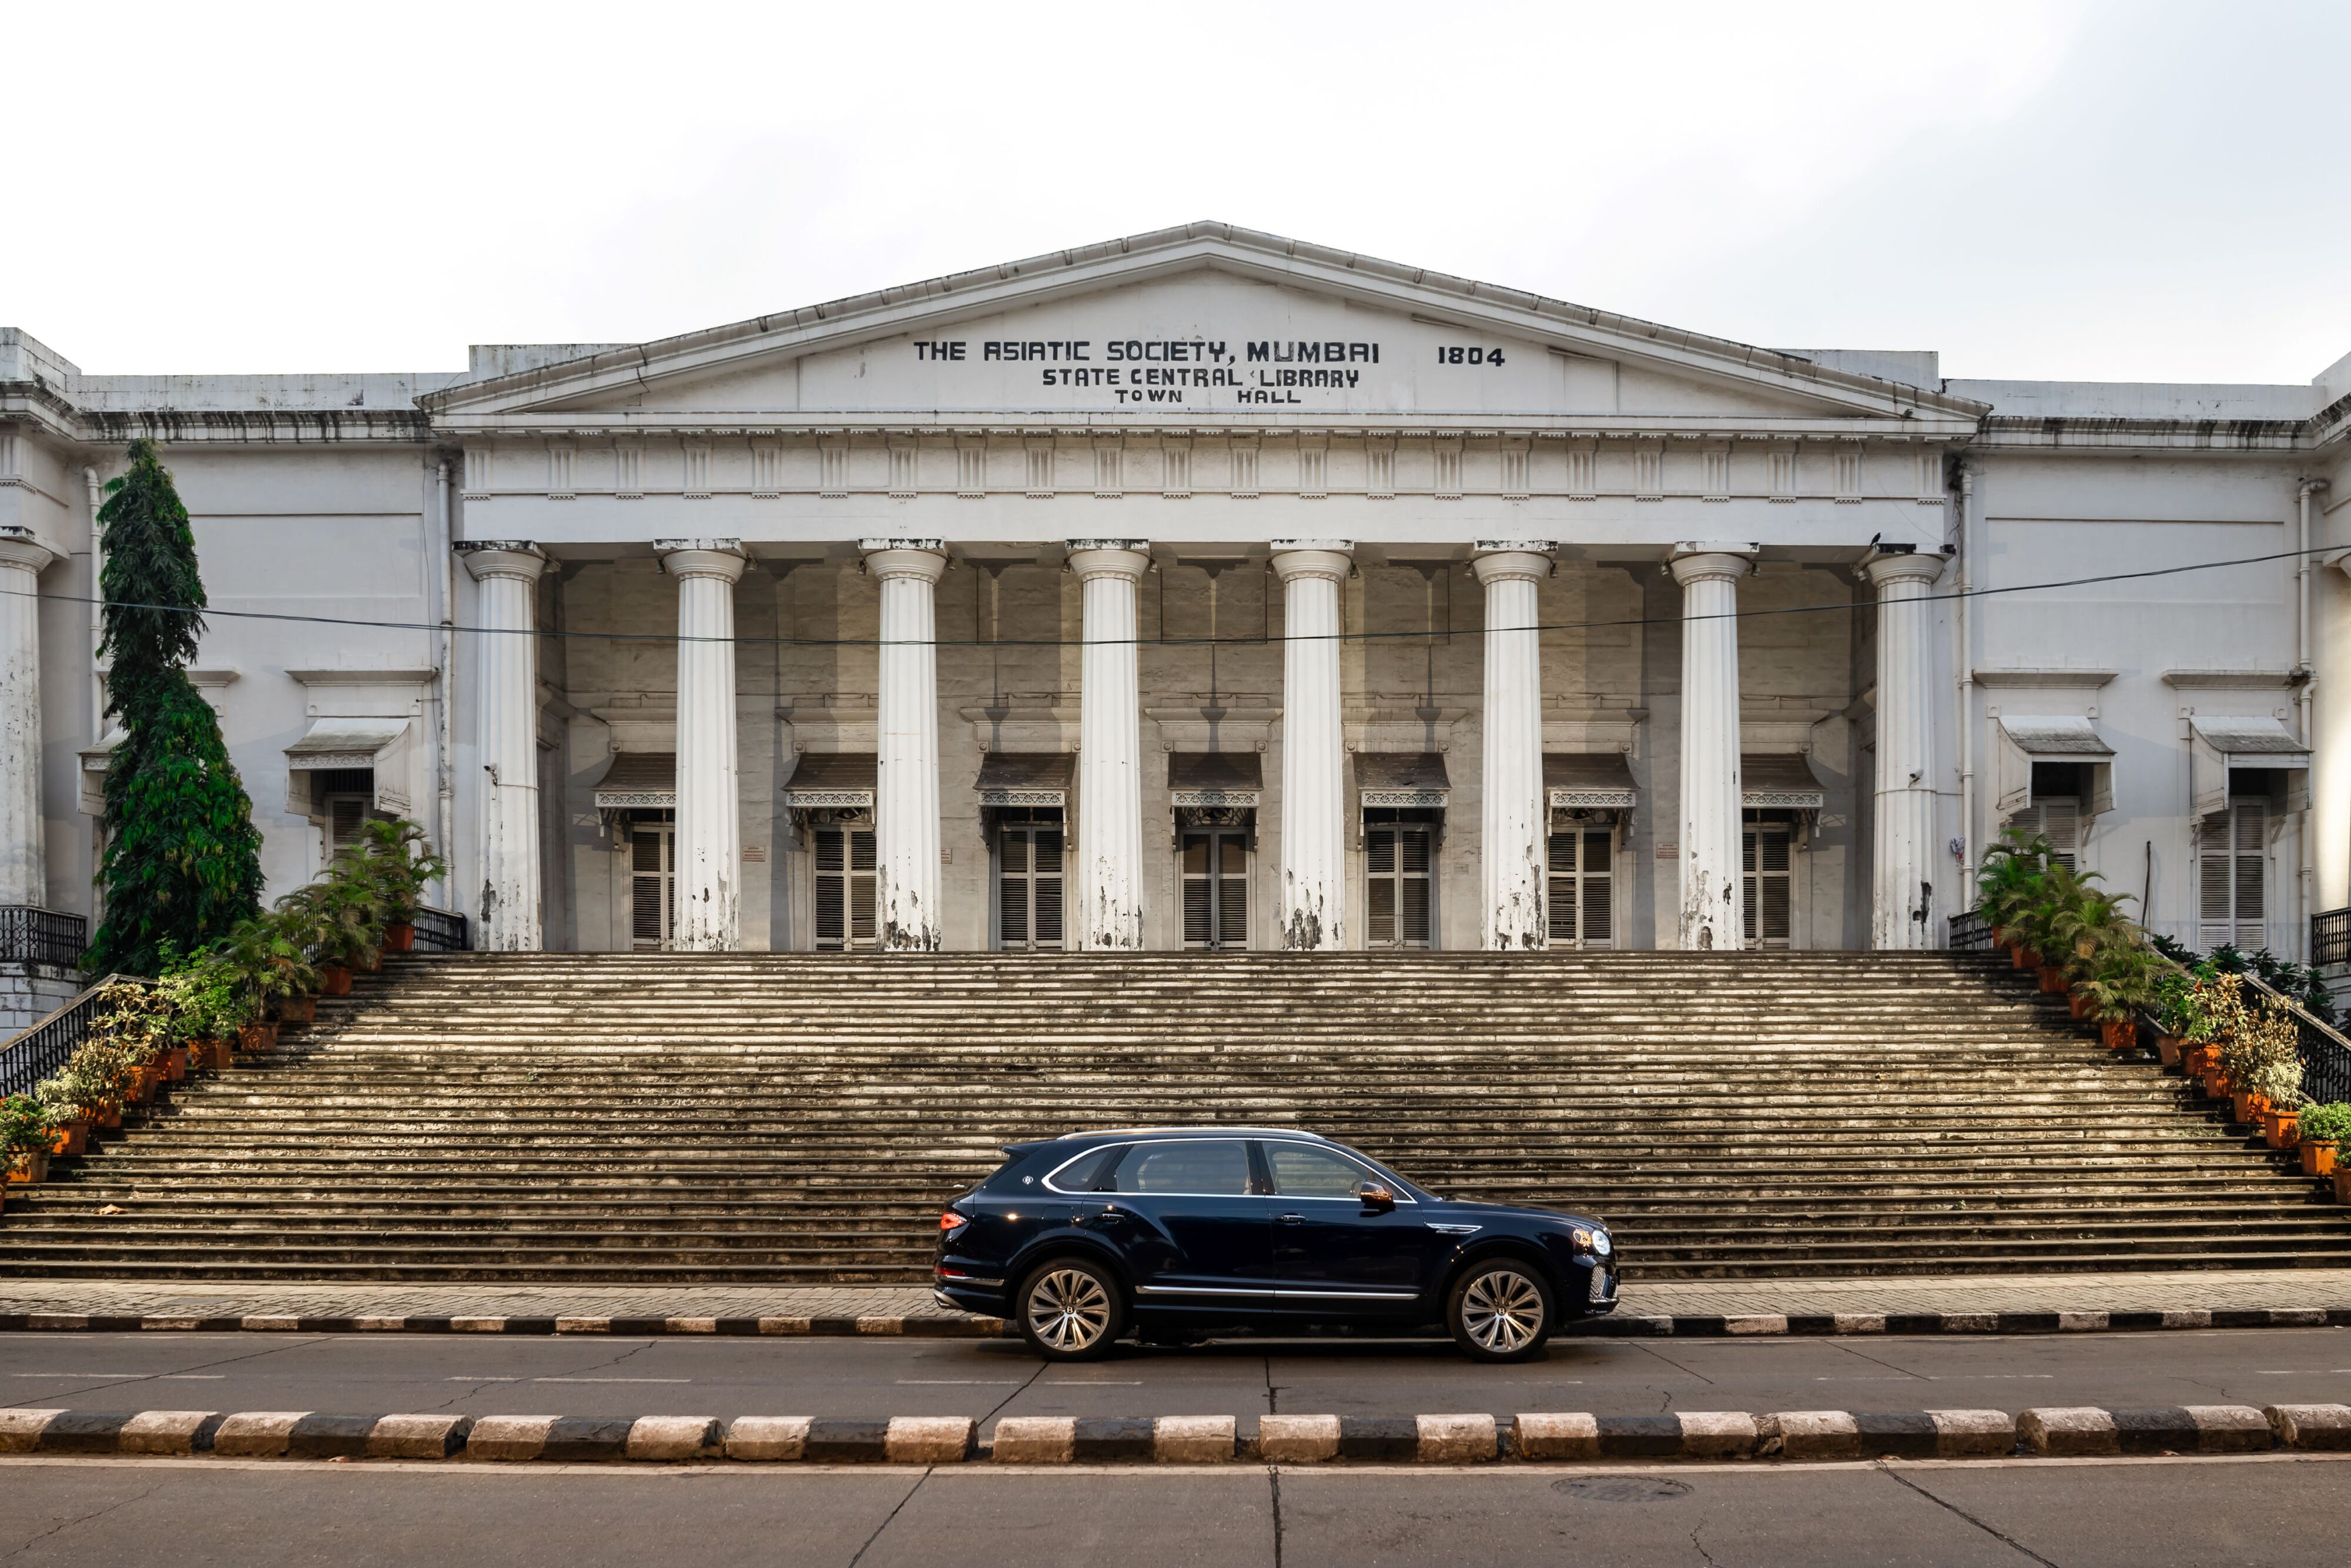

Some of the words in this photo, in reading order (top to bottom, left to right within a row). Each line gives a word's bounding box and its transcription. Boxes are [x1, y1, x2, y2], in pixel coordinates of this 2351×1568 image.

[913, 341, 966, 361] THE
[984, 341, 1090, 361] ASIATIC
[1107, 340, 1235, 366] SOCIETY,
[1247, 340, 1379, 364] MUMBAI
[1438, 346, 1506, 367] 1804
[1043, 368, 1120, 387] STATE
[1131, 368, 1243, 387] CENTRAL
[1260, 369, 1359, 388] LIBRARY
[1114, 389, 1182, 404] TOWN
[1237, 390, 1301, 404] HALL
